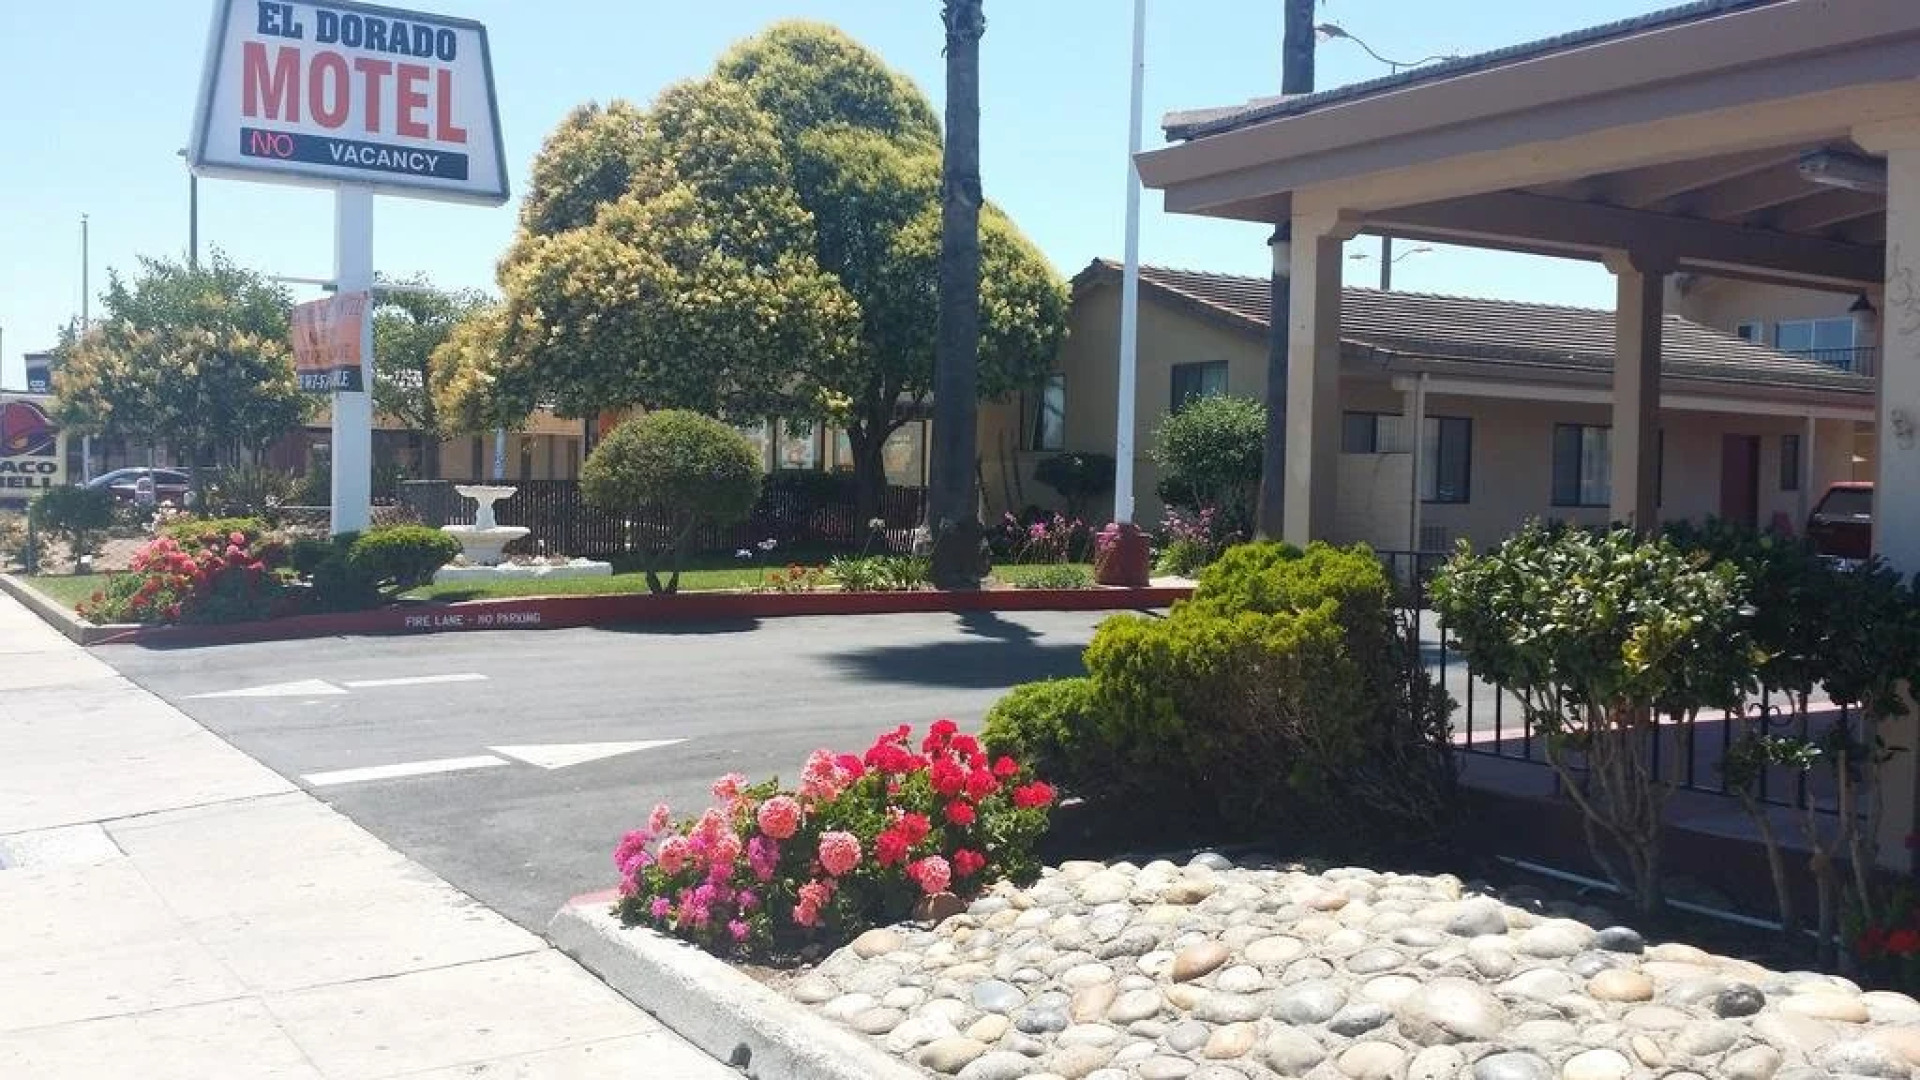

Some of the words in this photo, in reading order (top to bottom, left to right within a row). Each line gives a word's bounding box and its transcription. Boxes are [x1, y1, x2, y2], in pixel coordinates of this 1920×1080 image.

[257, 1, 303, 39] EL
[316, 9, 457, 62] DORADO
[242, 41, 468, 144] MOTEL
[252, 131, 294, 157] NO
[329, 143, 440, 172] VACANCY
[405, 614, 431, 627] FIRE
[434, 614, 464, 627] LANE
[478, 614, 494, 625] NO
[496, 612, 541, 624] PARKING
